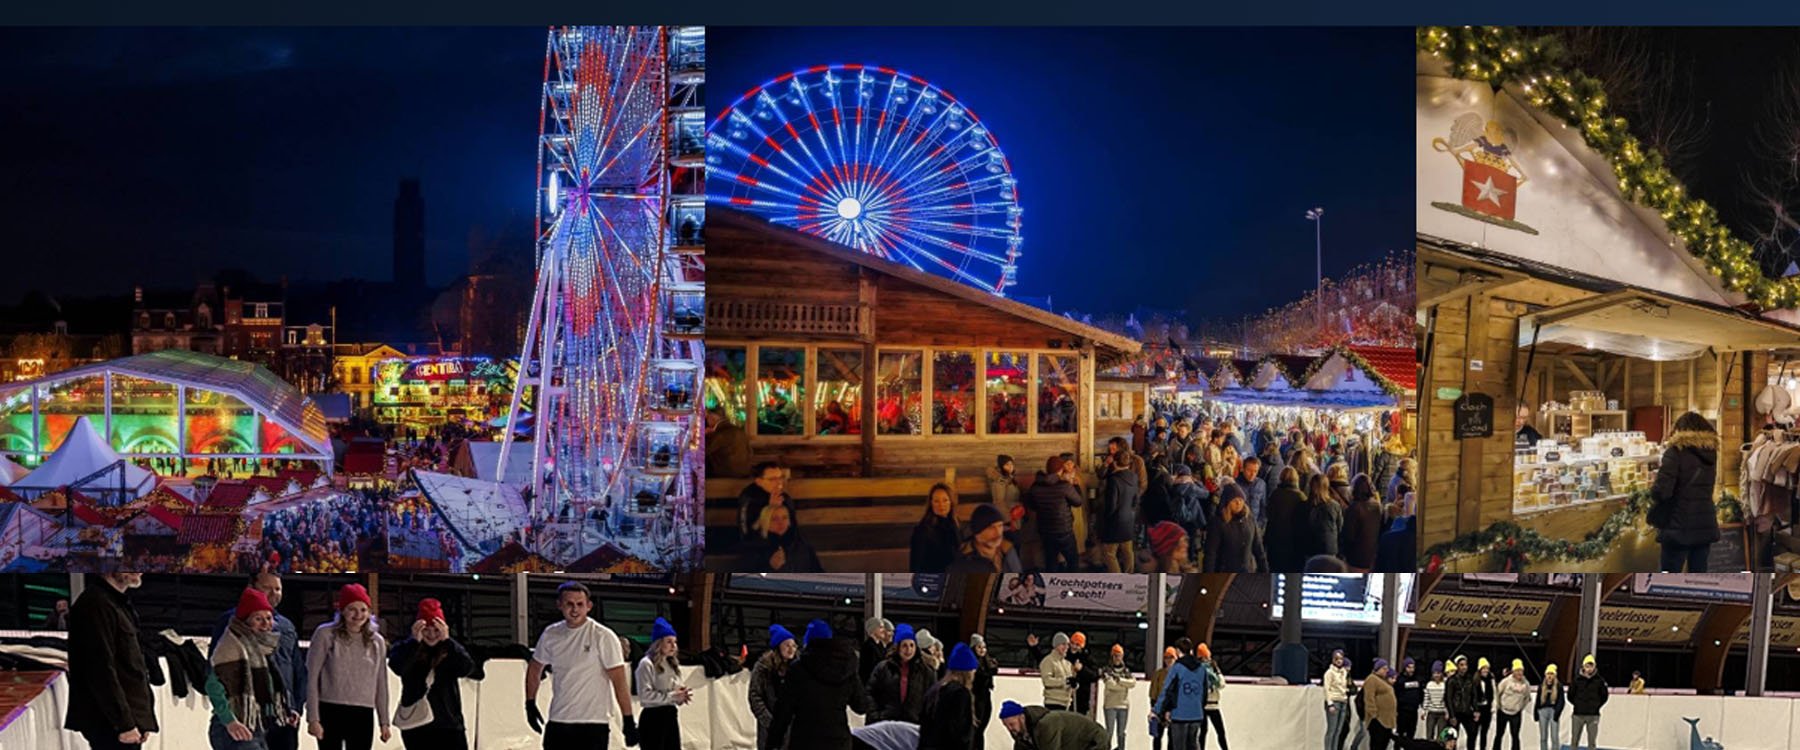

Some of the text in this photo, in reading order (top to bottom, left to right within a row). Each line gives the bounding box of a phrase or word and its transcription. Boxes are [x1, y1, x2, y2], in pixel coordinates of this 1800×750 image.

[1048, 576, 1123, 591] Krachtpatsers
[1440, 598, 1492, 615] lichaam
[1494, 602, 1511, 615] de
[1511, 603, 1543, 617] baas
[1437, 613, 1516, 630] krassport.nl
